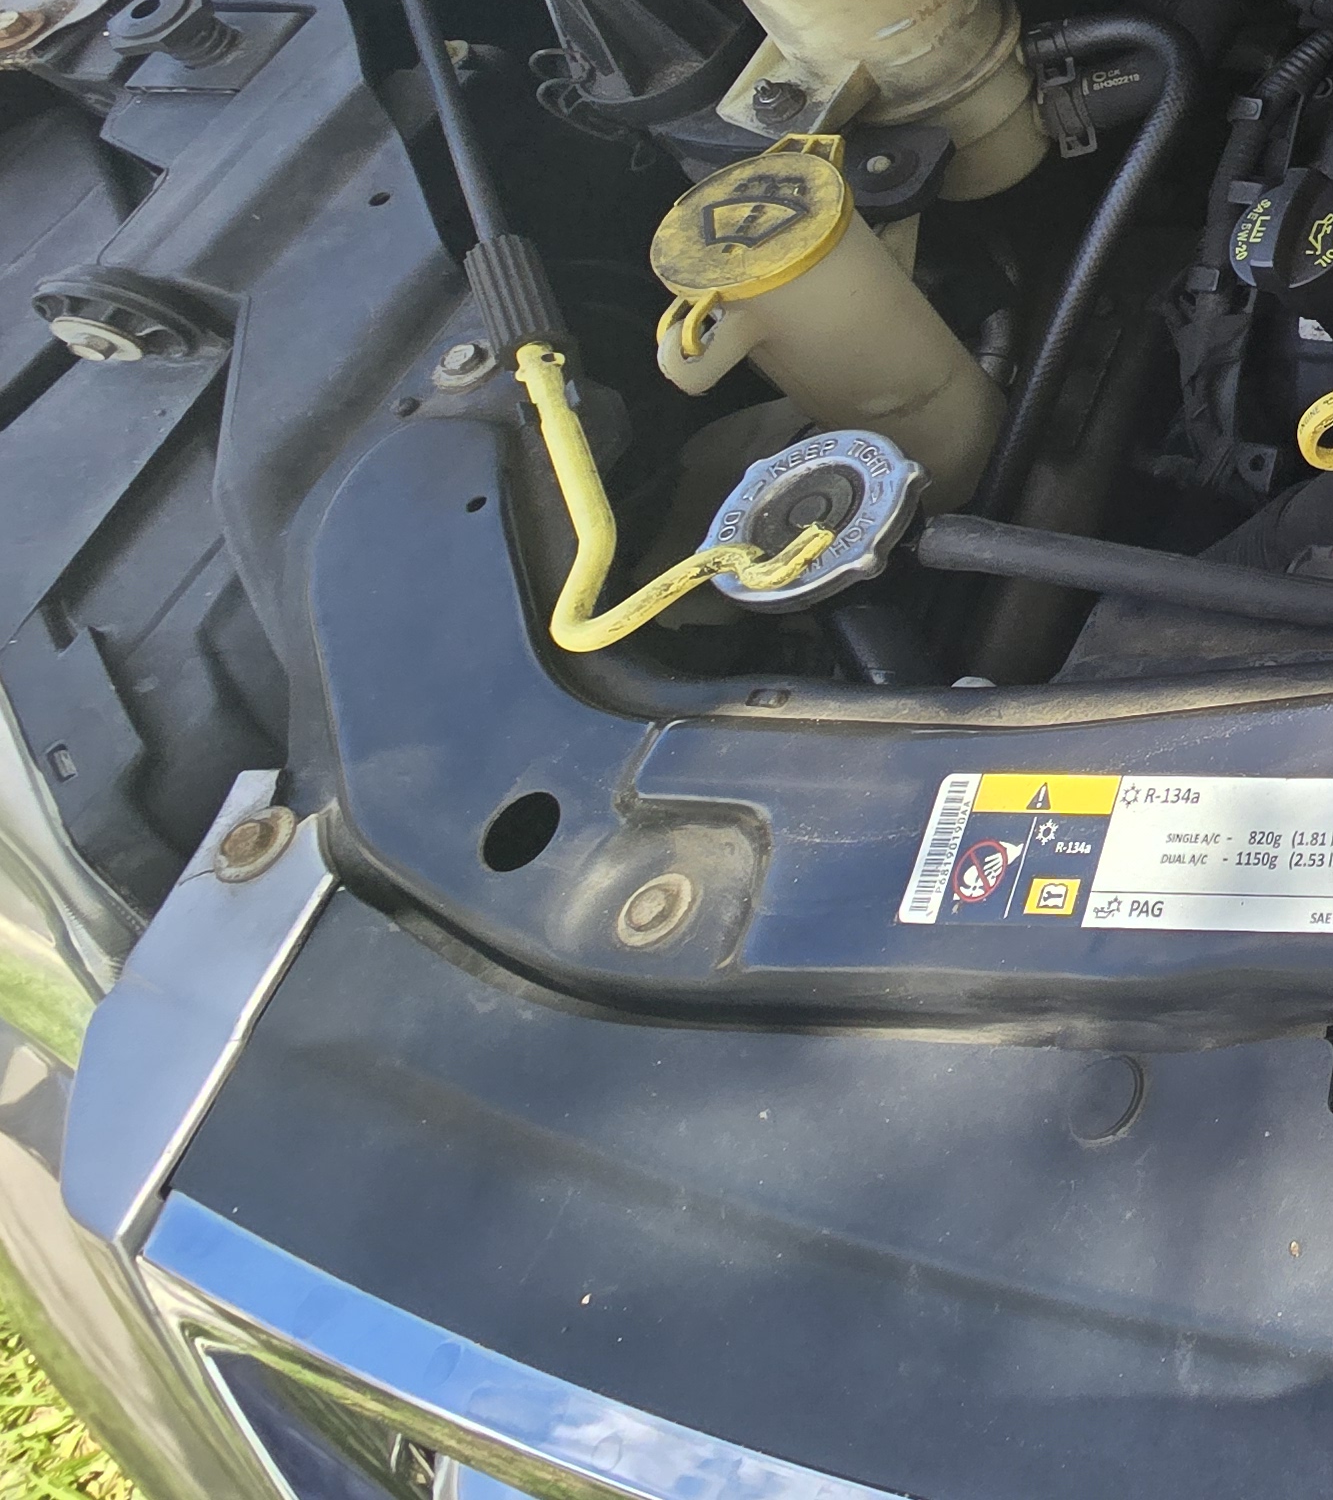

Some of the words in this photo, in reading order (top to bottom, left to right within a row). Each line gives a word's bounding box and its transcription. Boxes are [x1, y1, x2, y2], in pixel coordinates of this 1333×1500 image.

[1246, 199, 1272, 221] SAE
[1235, 221, 1253, 261] 5W-20
[768, 438, 839, 479] KEEP
[847, 439, 891, 478] TIGHT
[718, 510, 743, 542] DO
[829, 512, 876, 558] HOT
[1143, 787, 1201, 805] R-134a
[1055, 841, 1092, 854] R-134a
[1166, 833, 1200, 845] SINGLE
[1200, 833, 1220, 845] A/C
[1248, 830, 1282, 848] 820g
[1291, 830, 1327, 848] (1.81
[1160, 853, 1187, 865] DUAL
[1187, 853, 1208, 866] A/C
[1235, 851, 1278, 870] 1150g
[1288, 851, 1325, 870] (2.53
[1128, 900, 1164, 918] PAG
[1309, 912, 1332, 925] SAE
